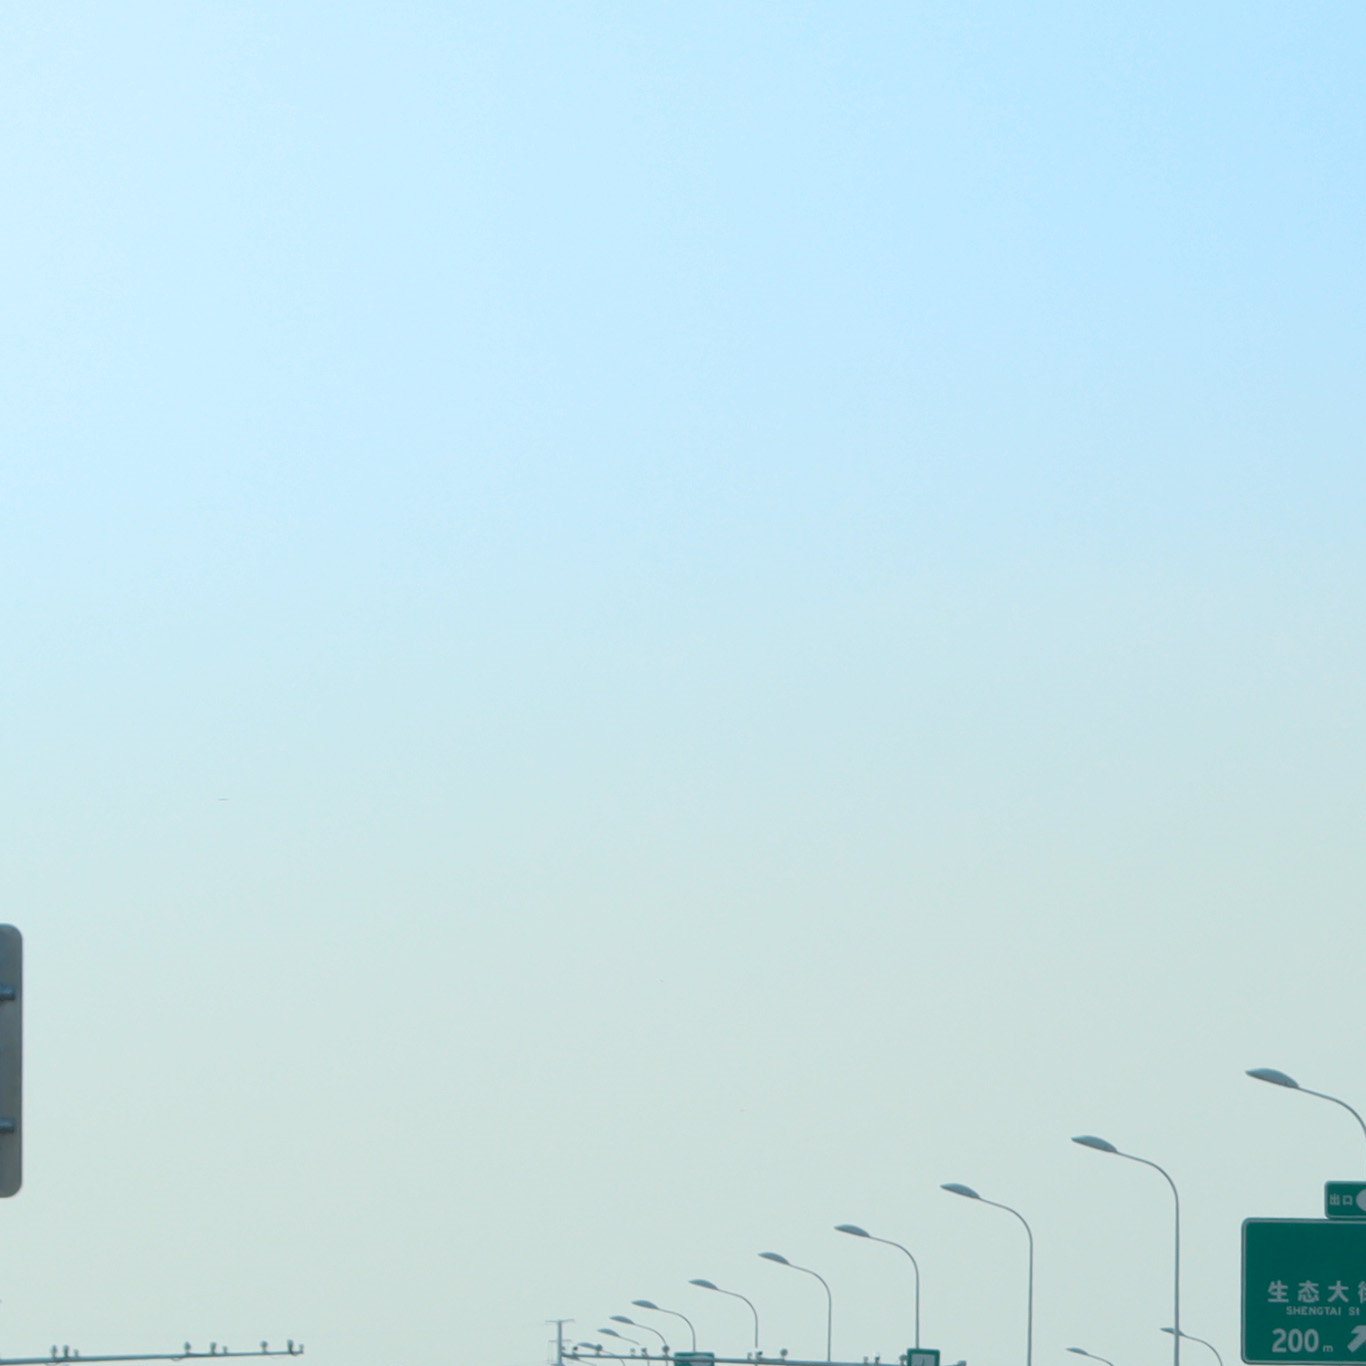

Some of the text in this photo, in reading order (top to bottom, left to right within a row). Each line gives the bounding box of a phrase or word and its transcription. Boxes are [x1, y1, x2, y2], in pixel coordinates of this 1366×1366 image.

[1329, 1193, 1353, 1206] 出口
[1286, 1306, 1360, 1316] SHENGTAI St
